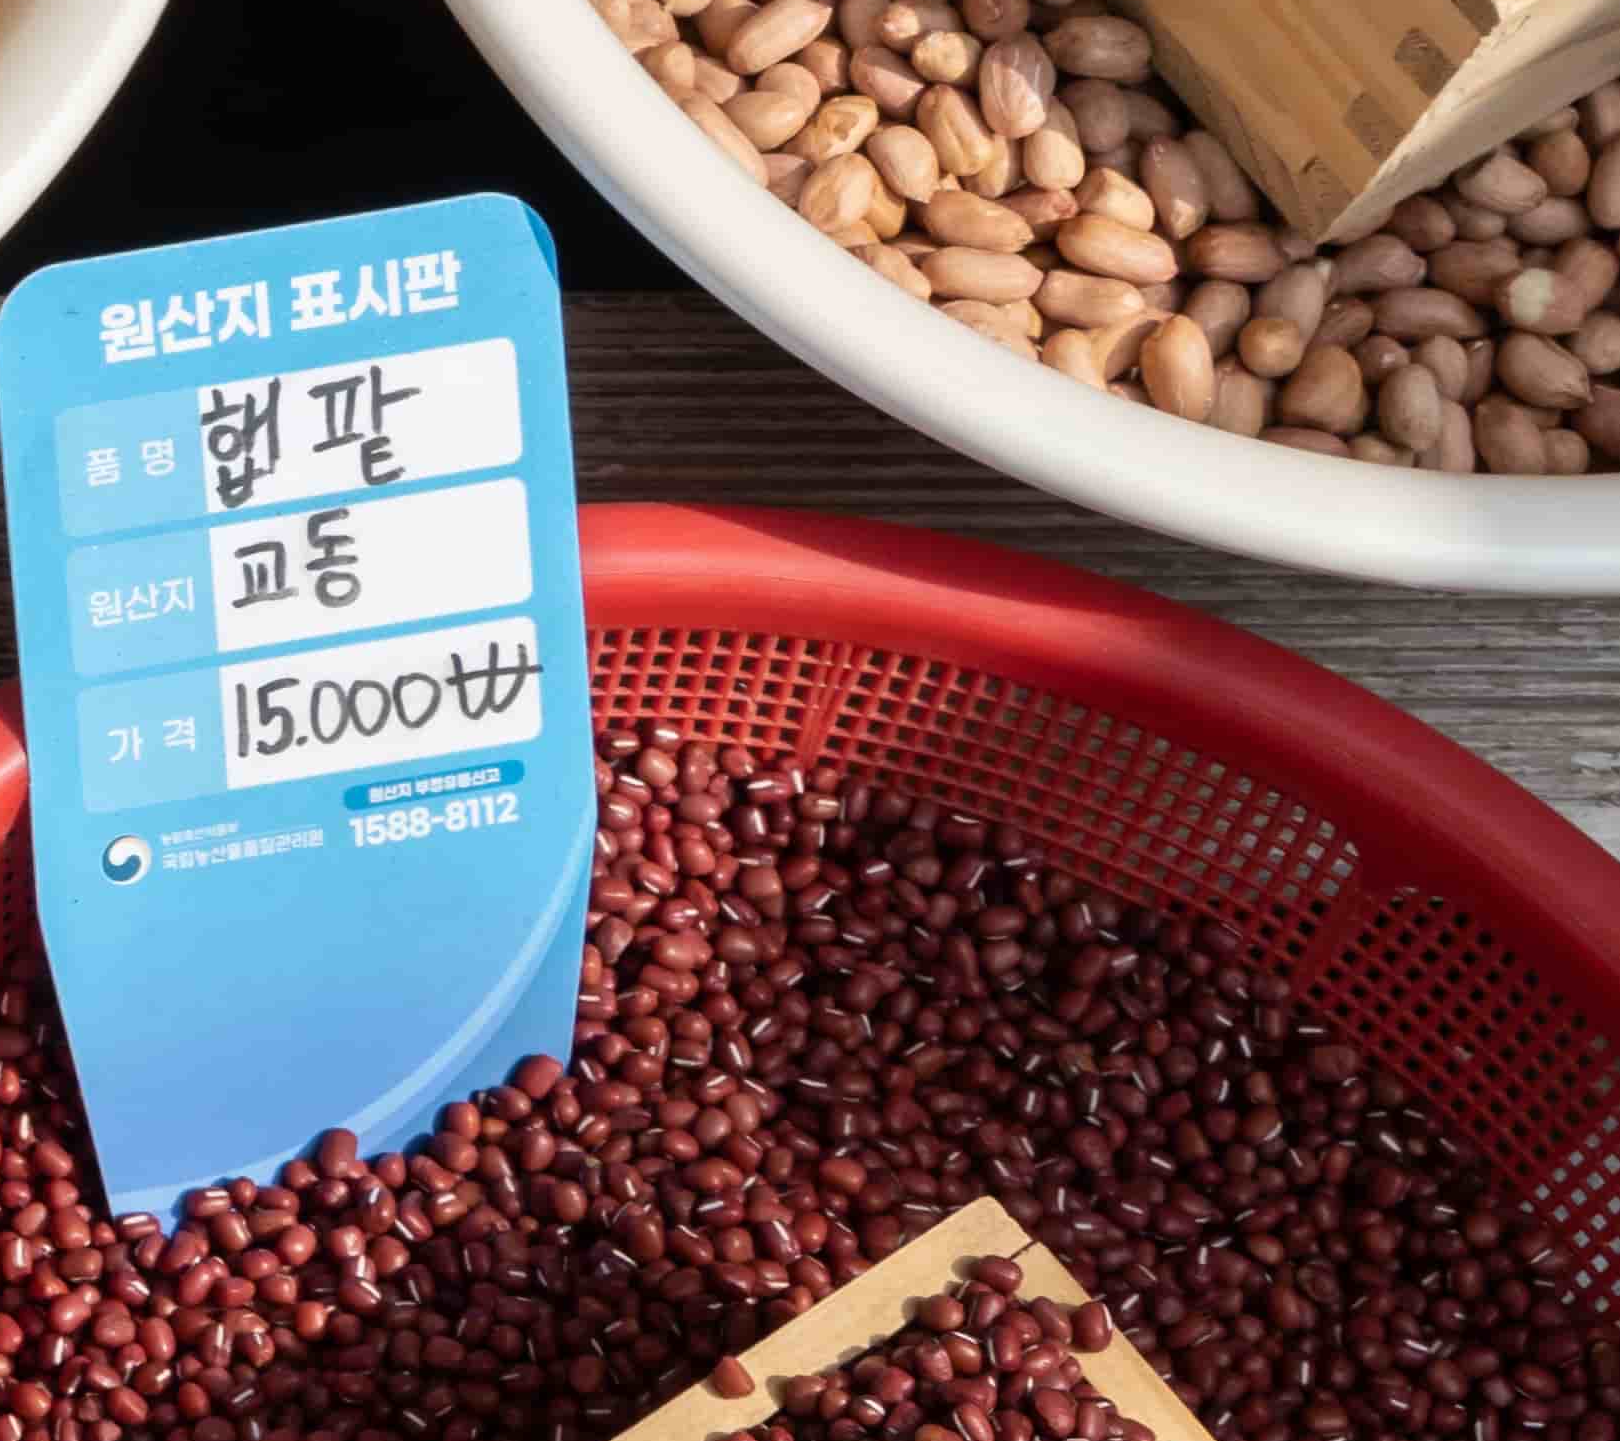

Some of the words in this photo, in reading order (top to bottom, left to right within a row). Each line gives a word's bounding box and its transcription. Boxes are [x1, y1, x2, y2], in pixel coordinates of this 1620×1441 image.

[98, 279, 272, 364] 원산지
[289, 249, 462, 334] 표시판
[231, 507, 362, 609] 교동
[88, 576, 197, 630] 원산지
[347, 792, 521, 848] 1588-8112
